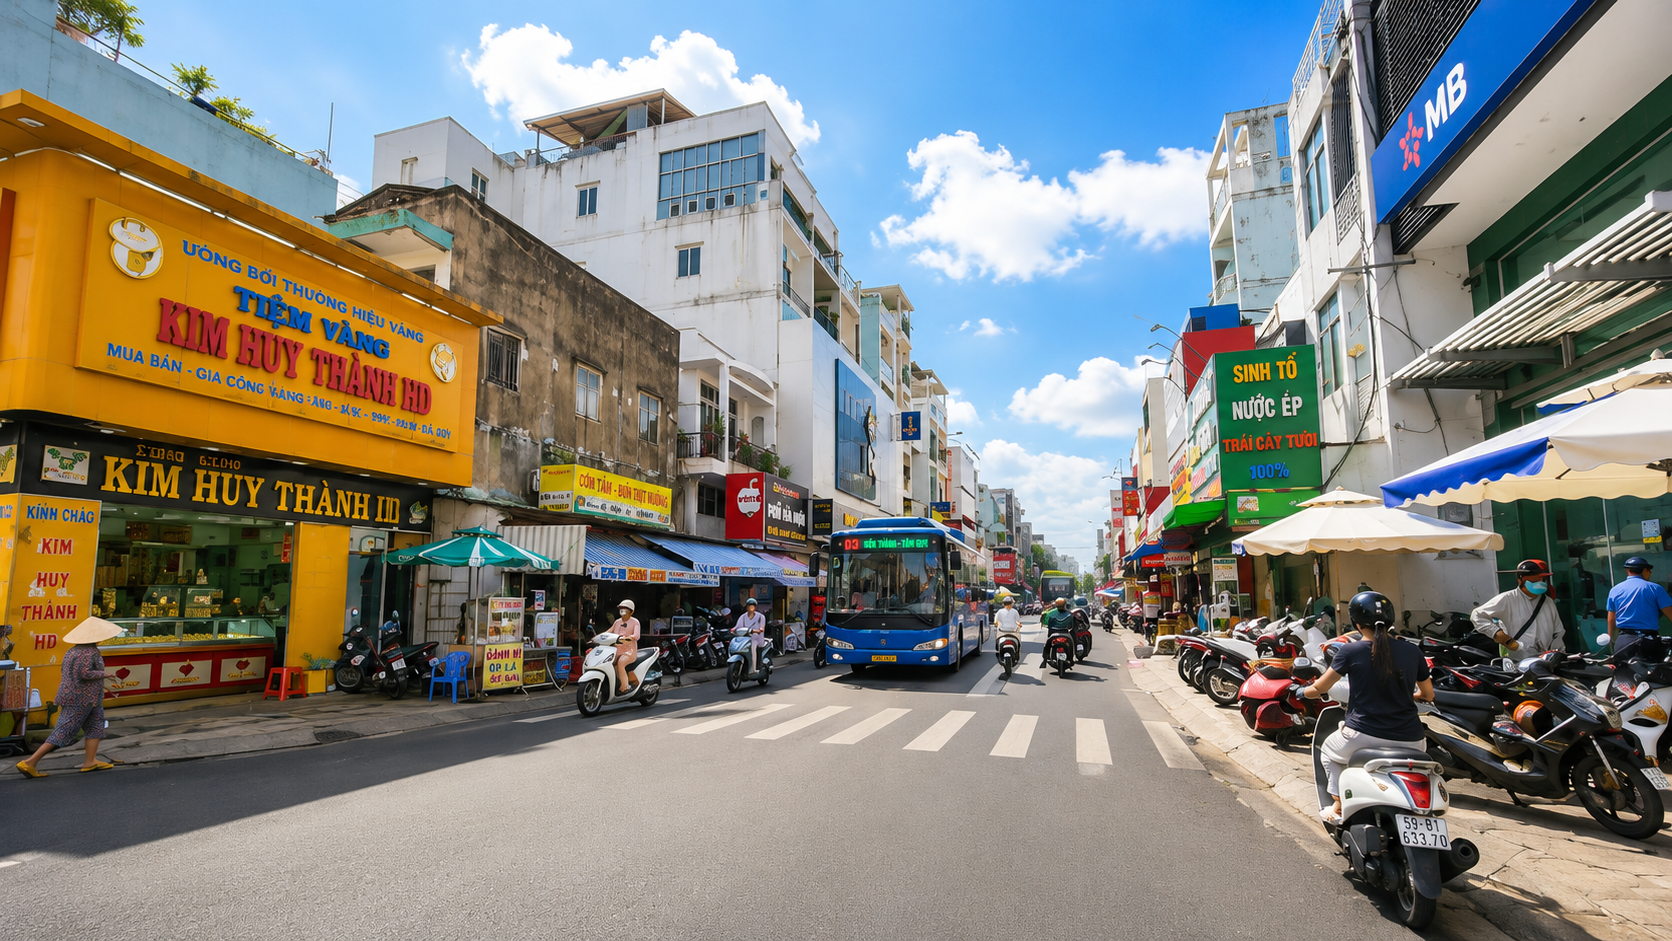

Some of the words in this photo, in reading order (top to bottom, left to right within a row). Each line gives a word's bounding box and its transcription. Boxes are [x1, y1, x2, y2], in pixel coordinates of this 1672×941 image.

[1424, 62, 1467, 143] MB
[234, 285, 312, 334] TIỆM
[321, 318, 390, 359] VÀNG
[106, 343, 145, 364] MUA
[196, 367, 222, 385] GIA
[226, 376, 265, 395] CÔNG
[157, 297, 230, 360] KIM
[236, 323, 304, 379] HUY
[311, 347, 398, 407] THÀNH
[401, 376, 432, 416] HD
[1233, 362, 1271, 384] SINH
[1276, 351, 1298, 380] TỐ
[1222, 433, 1253, 453] TRÁI
[1249, 462, 1290, 480] 100%
[100, 455, 183, 499] KIM
[191, 468, 265, 508] HUY
[274, 479, 370, 521] THÀNH
[42, 538, 73, 555] KIM
[37, 572, 70, 588] HUY
[34, 634, 57, 650] HD
[1403, 831, 1448, 848] 633.70
